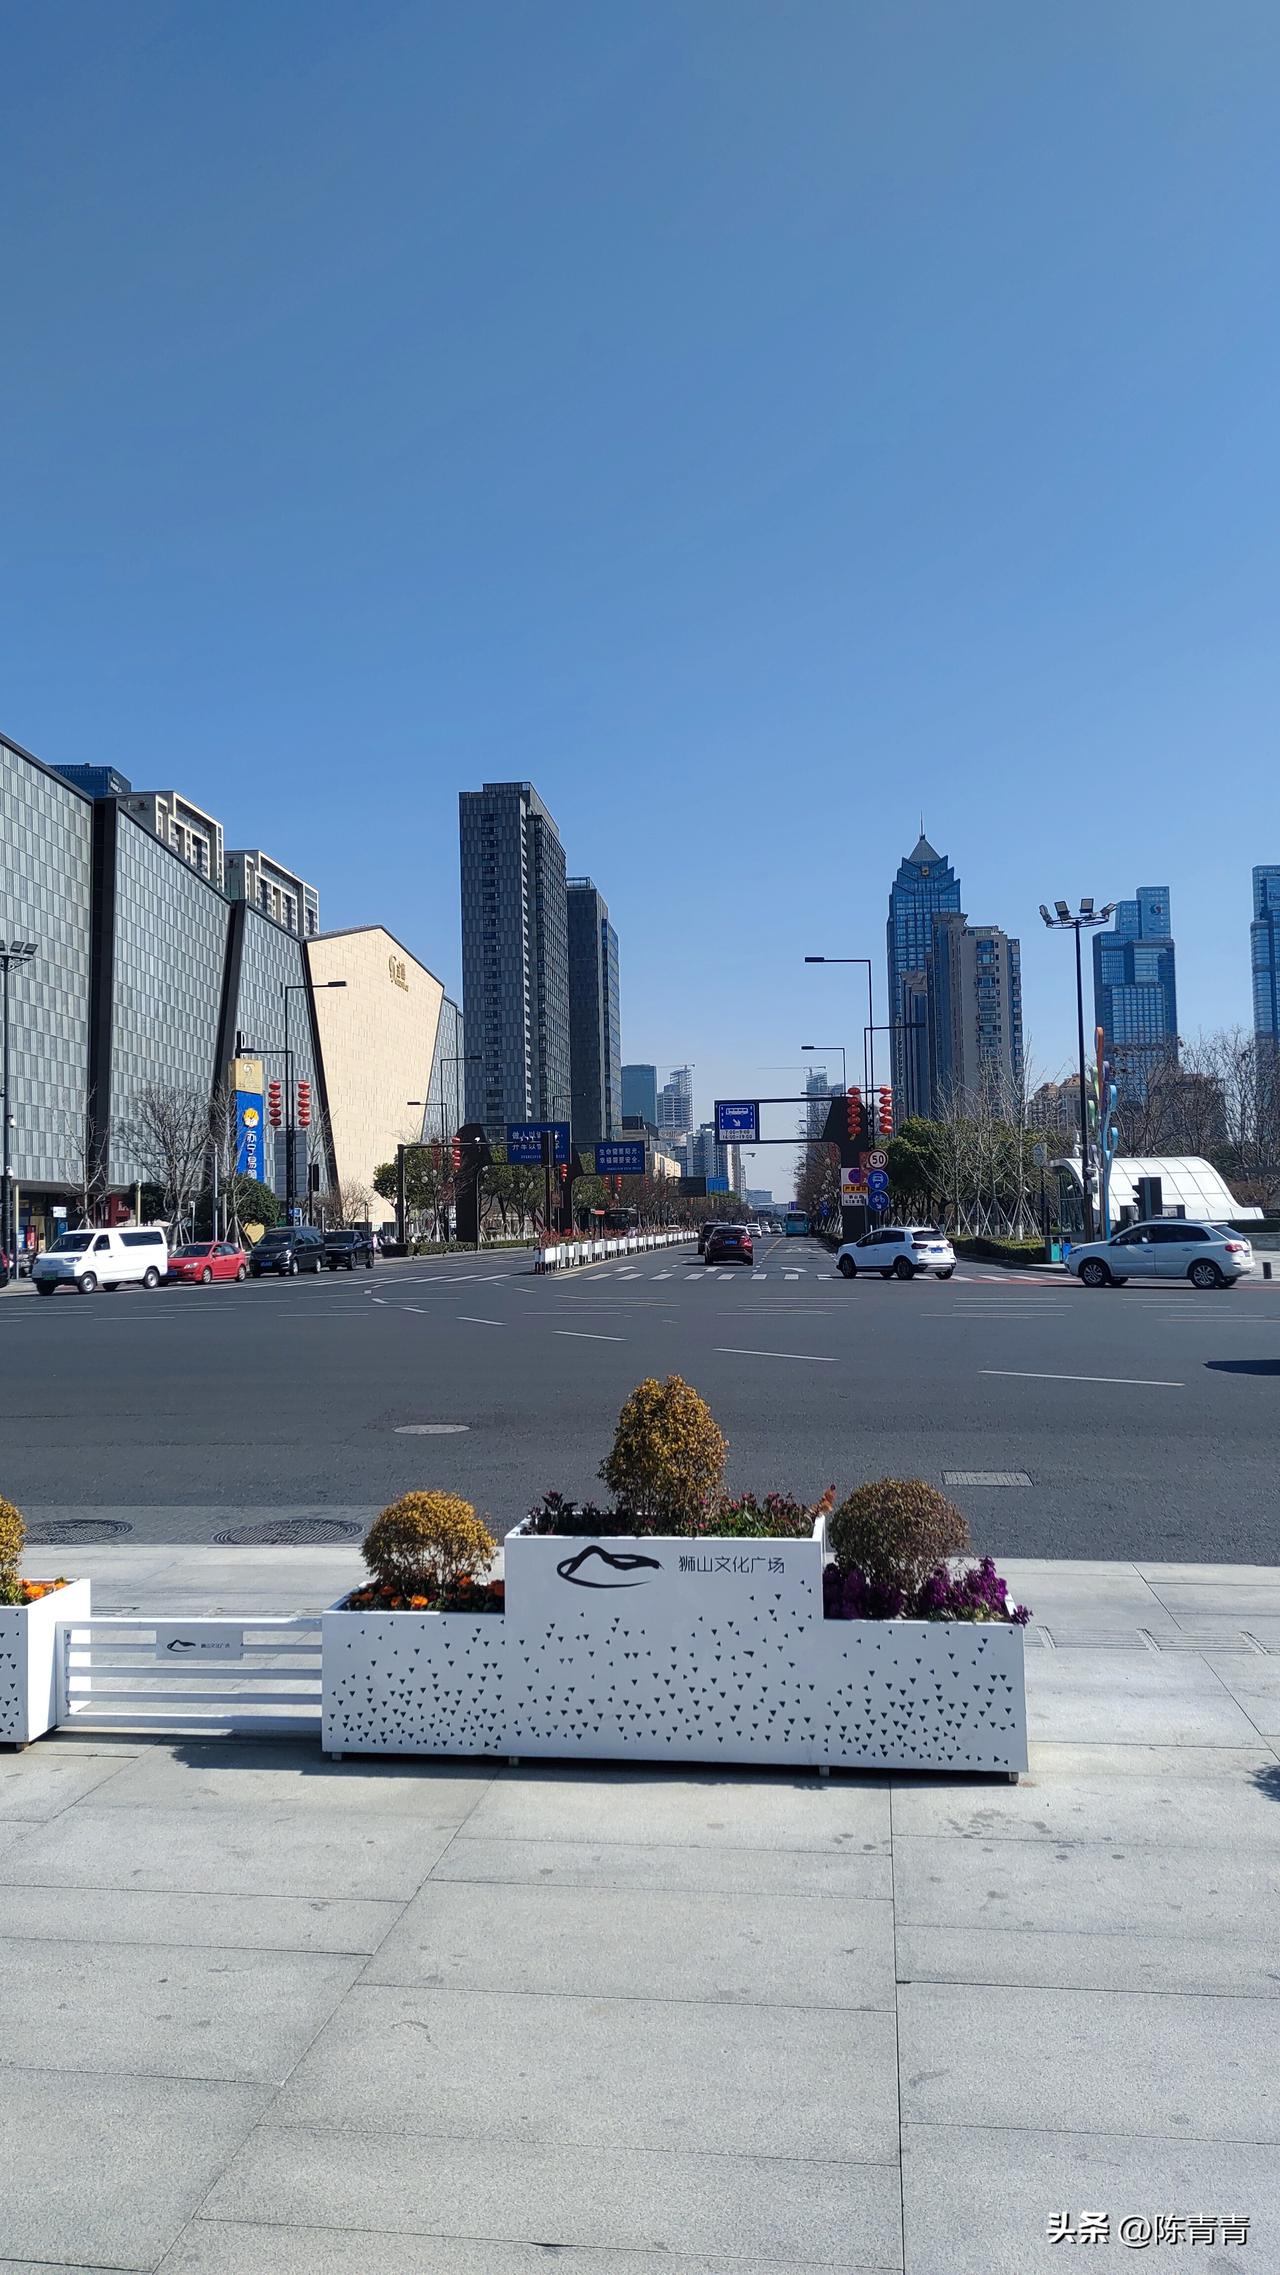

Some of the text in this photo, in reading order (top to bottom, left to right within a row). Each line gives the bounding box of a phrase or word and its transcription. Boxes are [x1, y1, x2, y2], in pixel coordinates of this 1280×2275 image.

[872, 1155, 884, 1165] 50
[678, 1554, 785, 1574] 狮山文化广场
